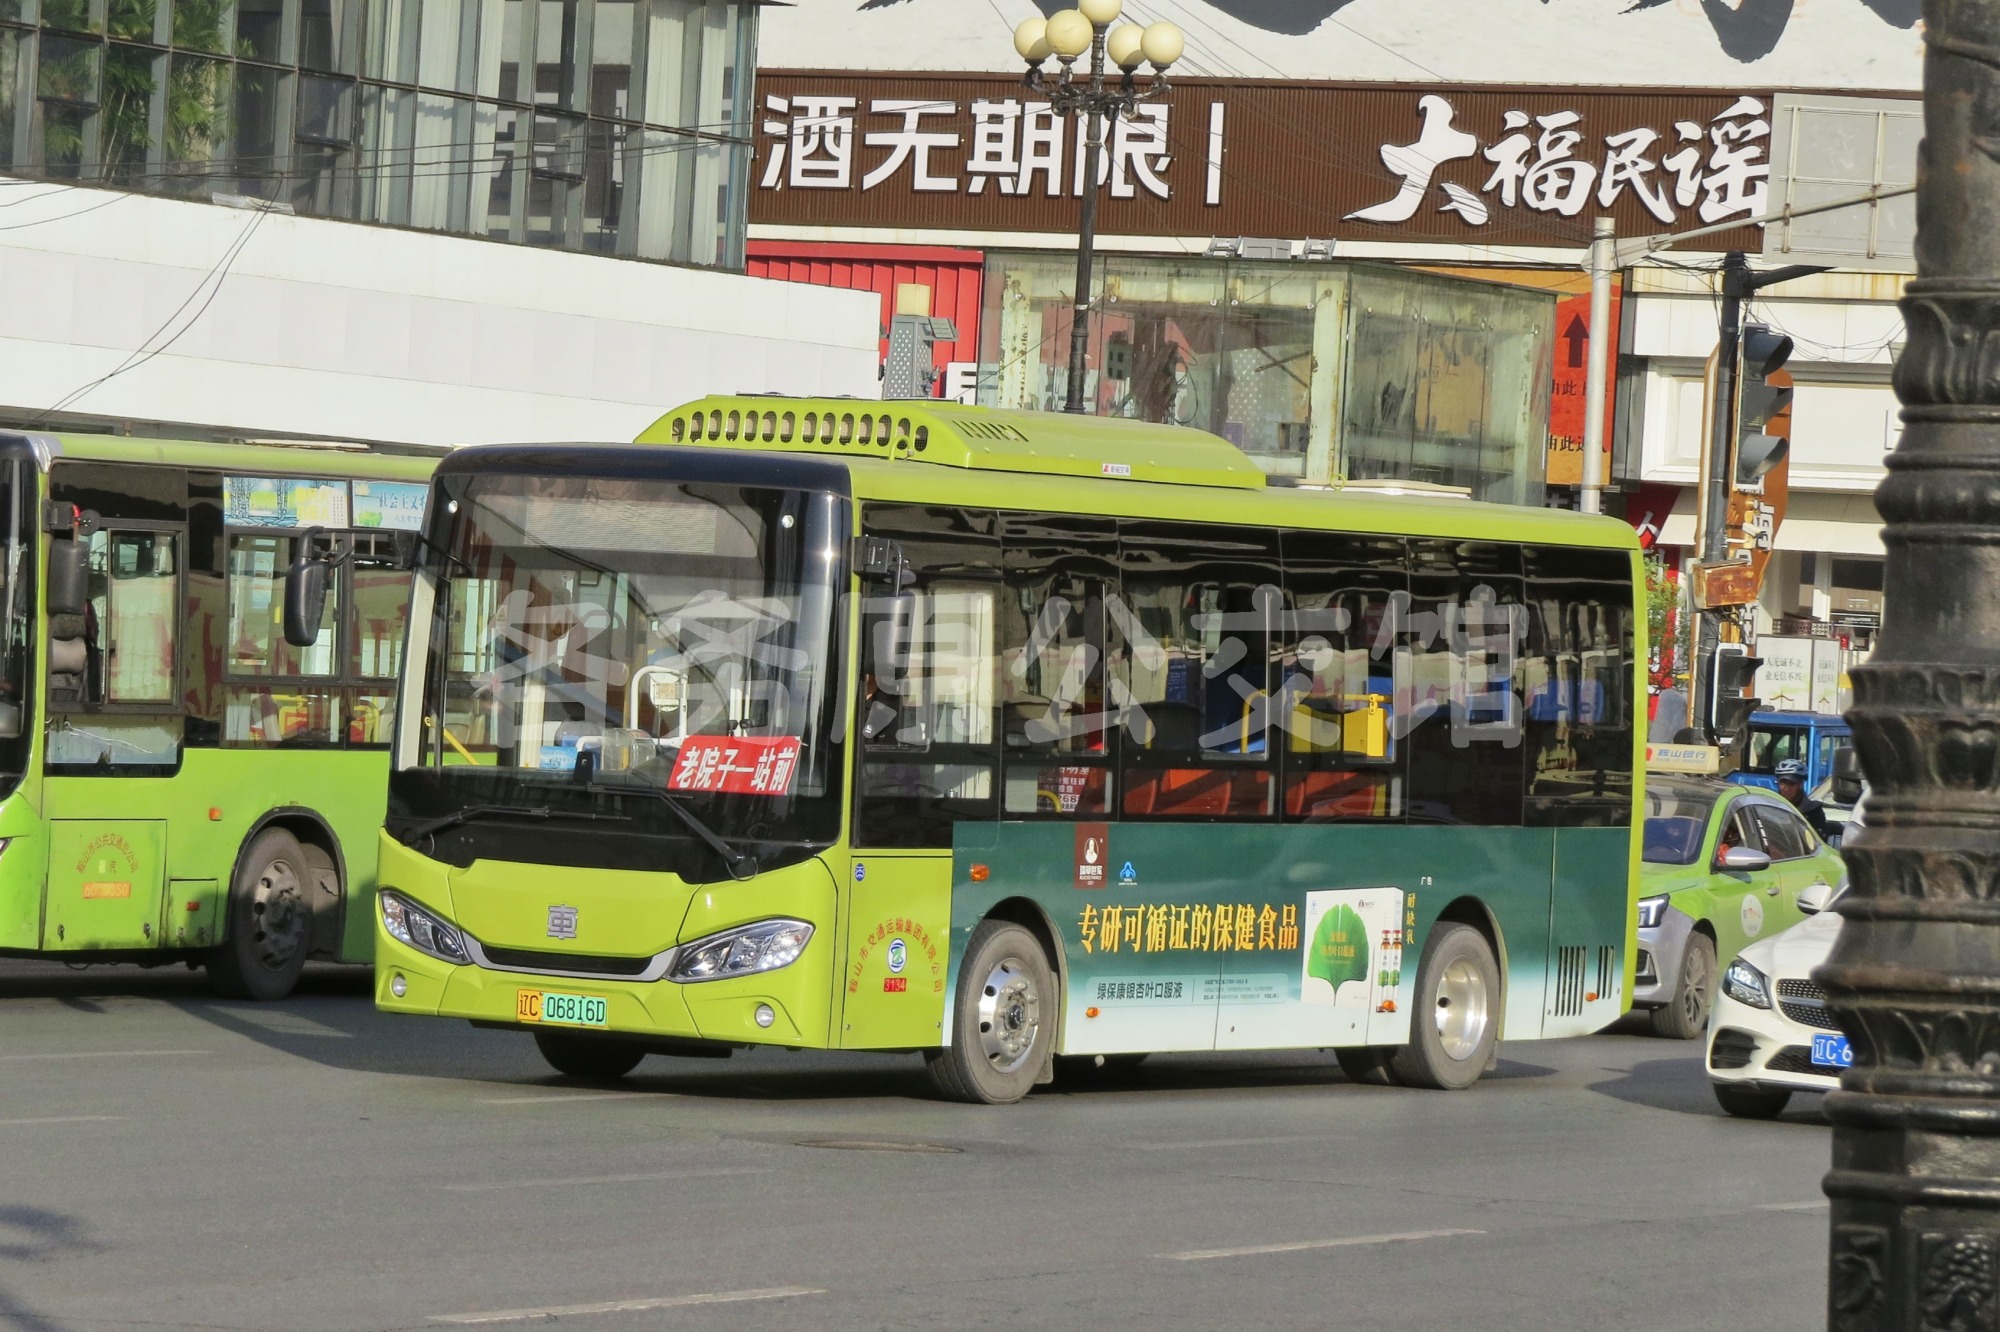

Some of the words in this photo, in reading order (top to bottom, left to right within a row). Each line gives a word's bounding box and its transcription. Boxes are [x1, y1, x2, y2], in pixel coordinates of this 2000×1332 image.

[1341, 94, 1770, 228] 大福民谣
[1549, 434, 1607, 454] 由此进
[1658, 748, 1706, 760] 鞍山银行
[1420, 876, 1433, 886] 广告
[1077, 902, 1299, 954] 专研可循证的保健食品
[884, 978, 906, 992] 3134
[1097, 981, 1183, 1001] 绿保康银杏叶口服液
